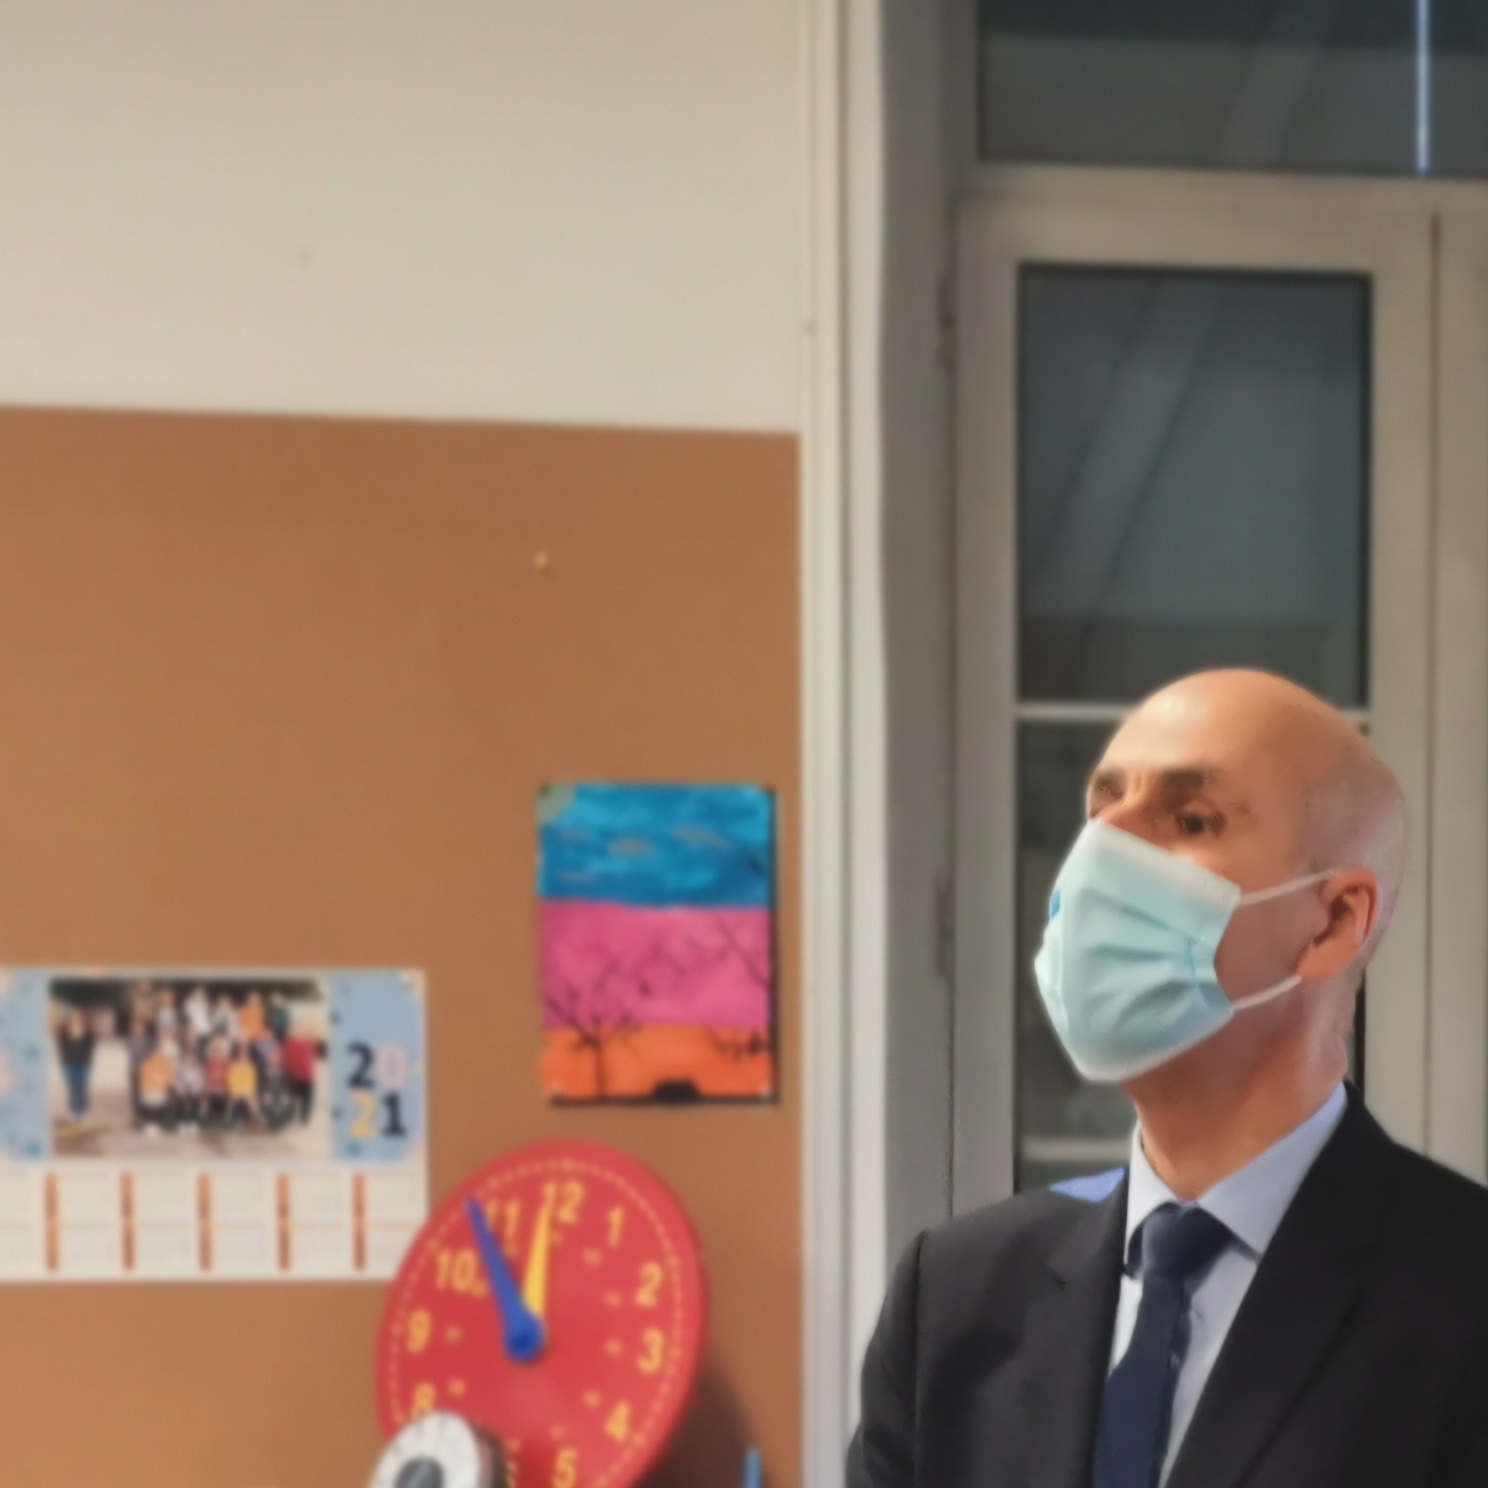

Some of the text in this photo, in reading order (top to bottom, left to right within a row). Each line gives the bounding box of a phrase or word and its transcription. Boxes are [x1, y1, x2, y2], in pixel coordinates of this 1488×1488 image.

[606, 1206, 625, 1246] 1
[436, 1249, 475, 1292] 10
[635, 1262, 664, 1307] 2
[407, 1309, 432, 1354] 9
[638, 1329, 665, 1375] 3
[605, 1401, 632, 1441] 4
